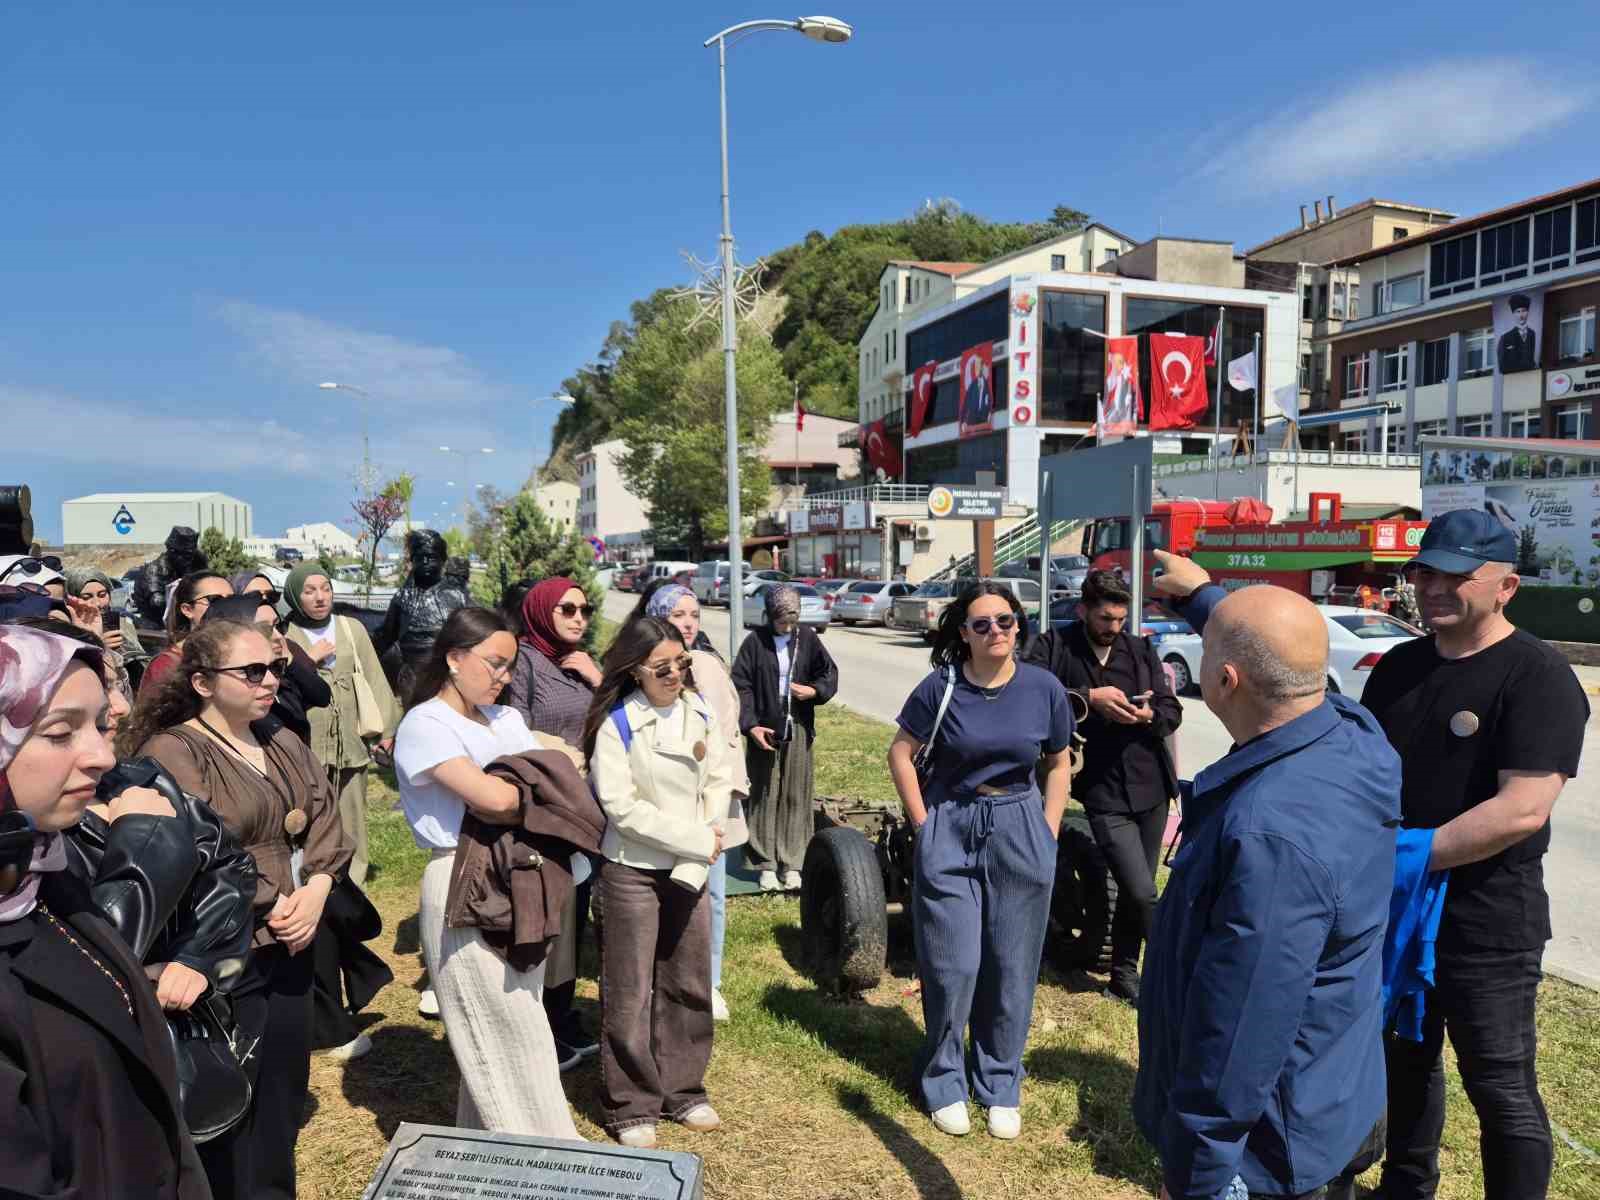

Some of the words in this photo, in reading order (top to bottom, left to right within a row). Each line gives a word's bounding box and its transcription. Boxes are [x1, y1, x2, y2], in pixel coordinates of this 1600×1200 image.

[1013, 320, 1031, 425] İTSO
[434, 1149, 461, 1161] BEYAZ
[571, 1163, 587, 1174] TEK
